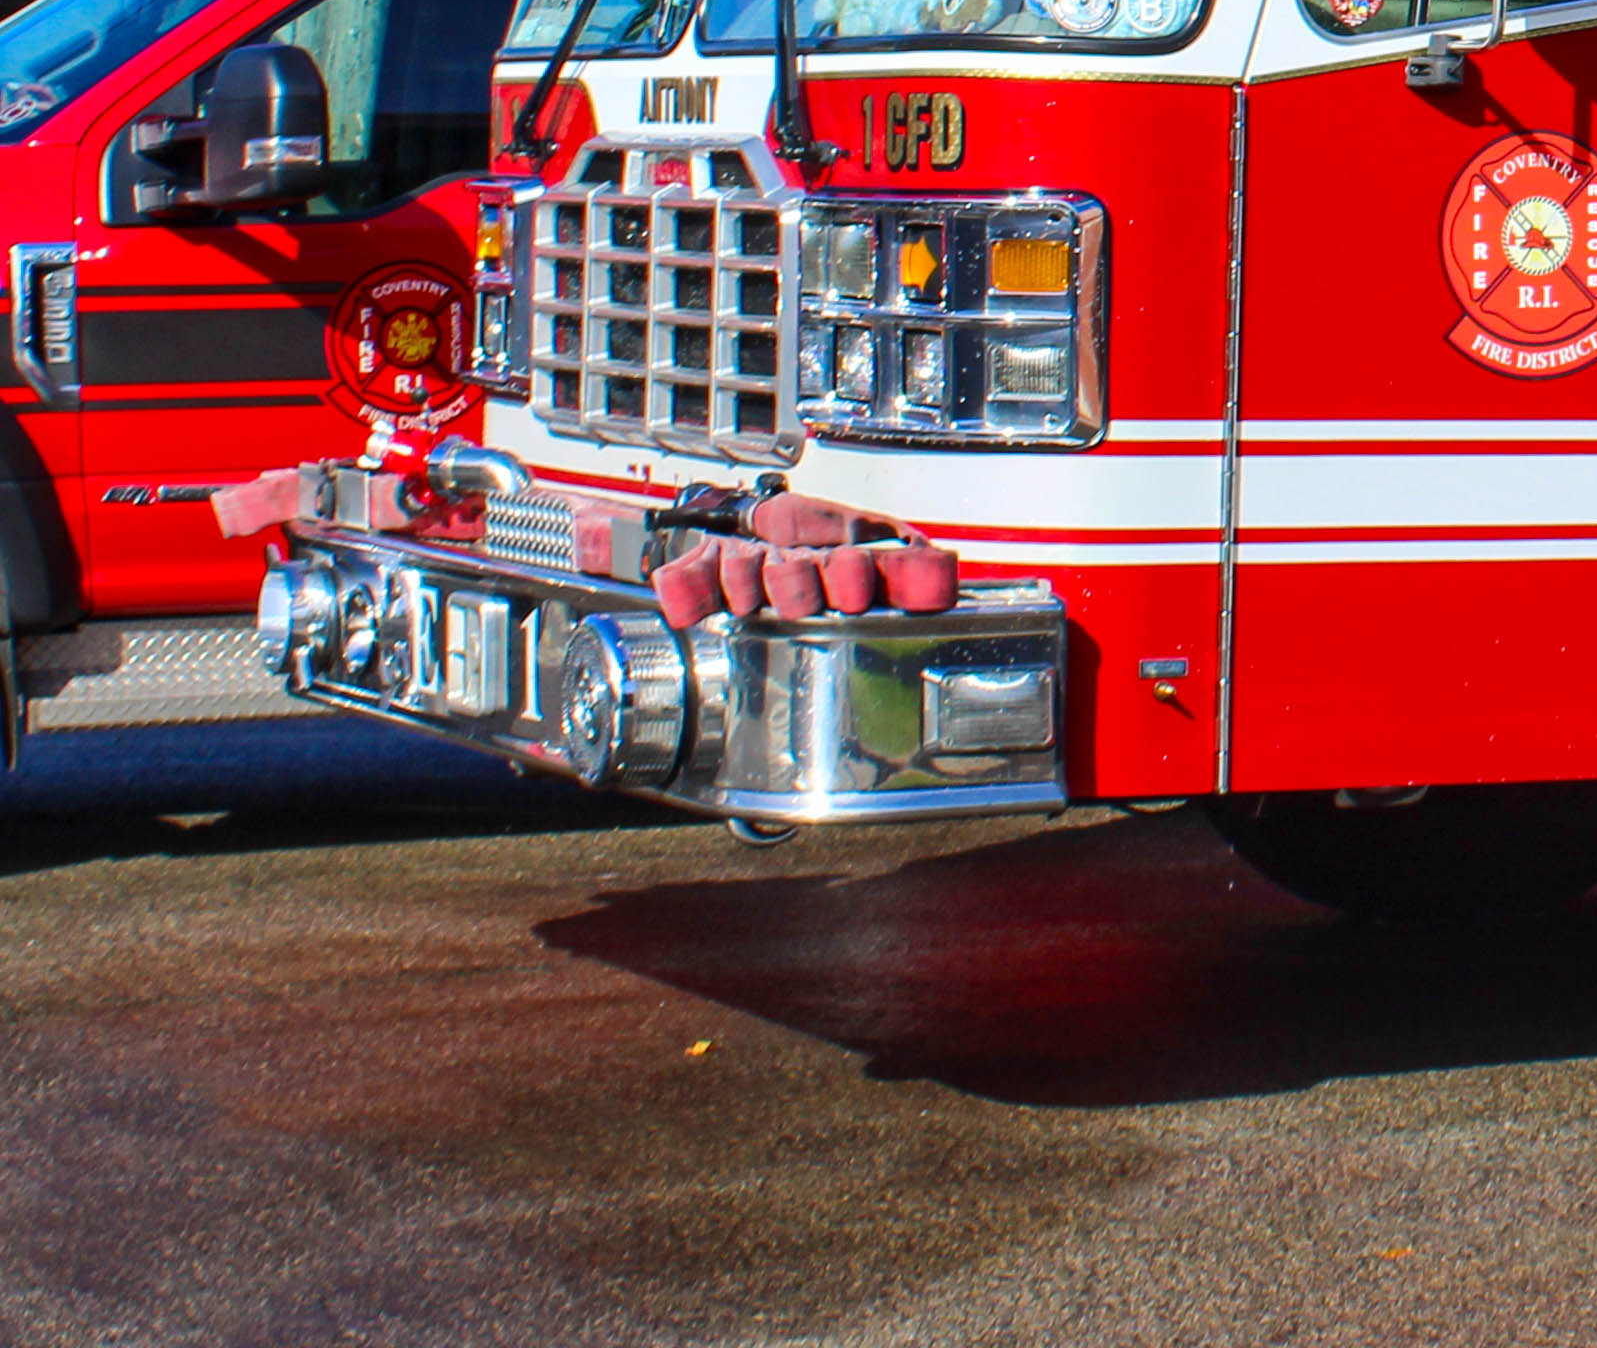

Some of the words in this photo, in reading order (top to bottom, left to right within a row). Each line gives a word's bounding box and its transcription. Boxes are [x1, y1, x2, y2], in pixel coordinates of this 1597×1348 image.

[886, 92, 966, 173] CFD
[1492, 152, 1583, 185] COVENTRY
[1473, 184, 1489, 290] FIRE
[371, 279, 452, 300] COVENTRY
[1517, 285, 1560, 309] R.I.
[358, 307, 376, 374] FIRE
[1471, 334, 1514, 366] FIRE
[398, 395, 469, 431] DISRICT
